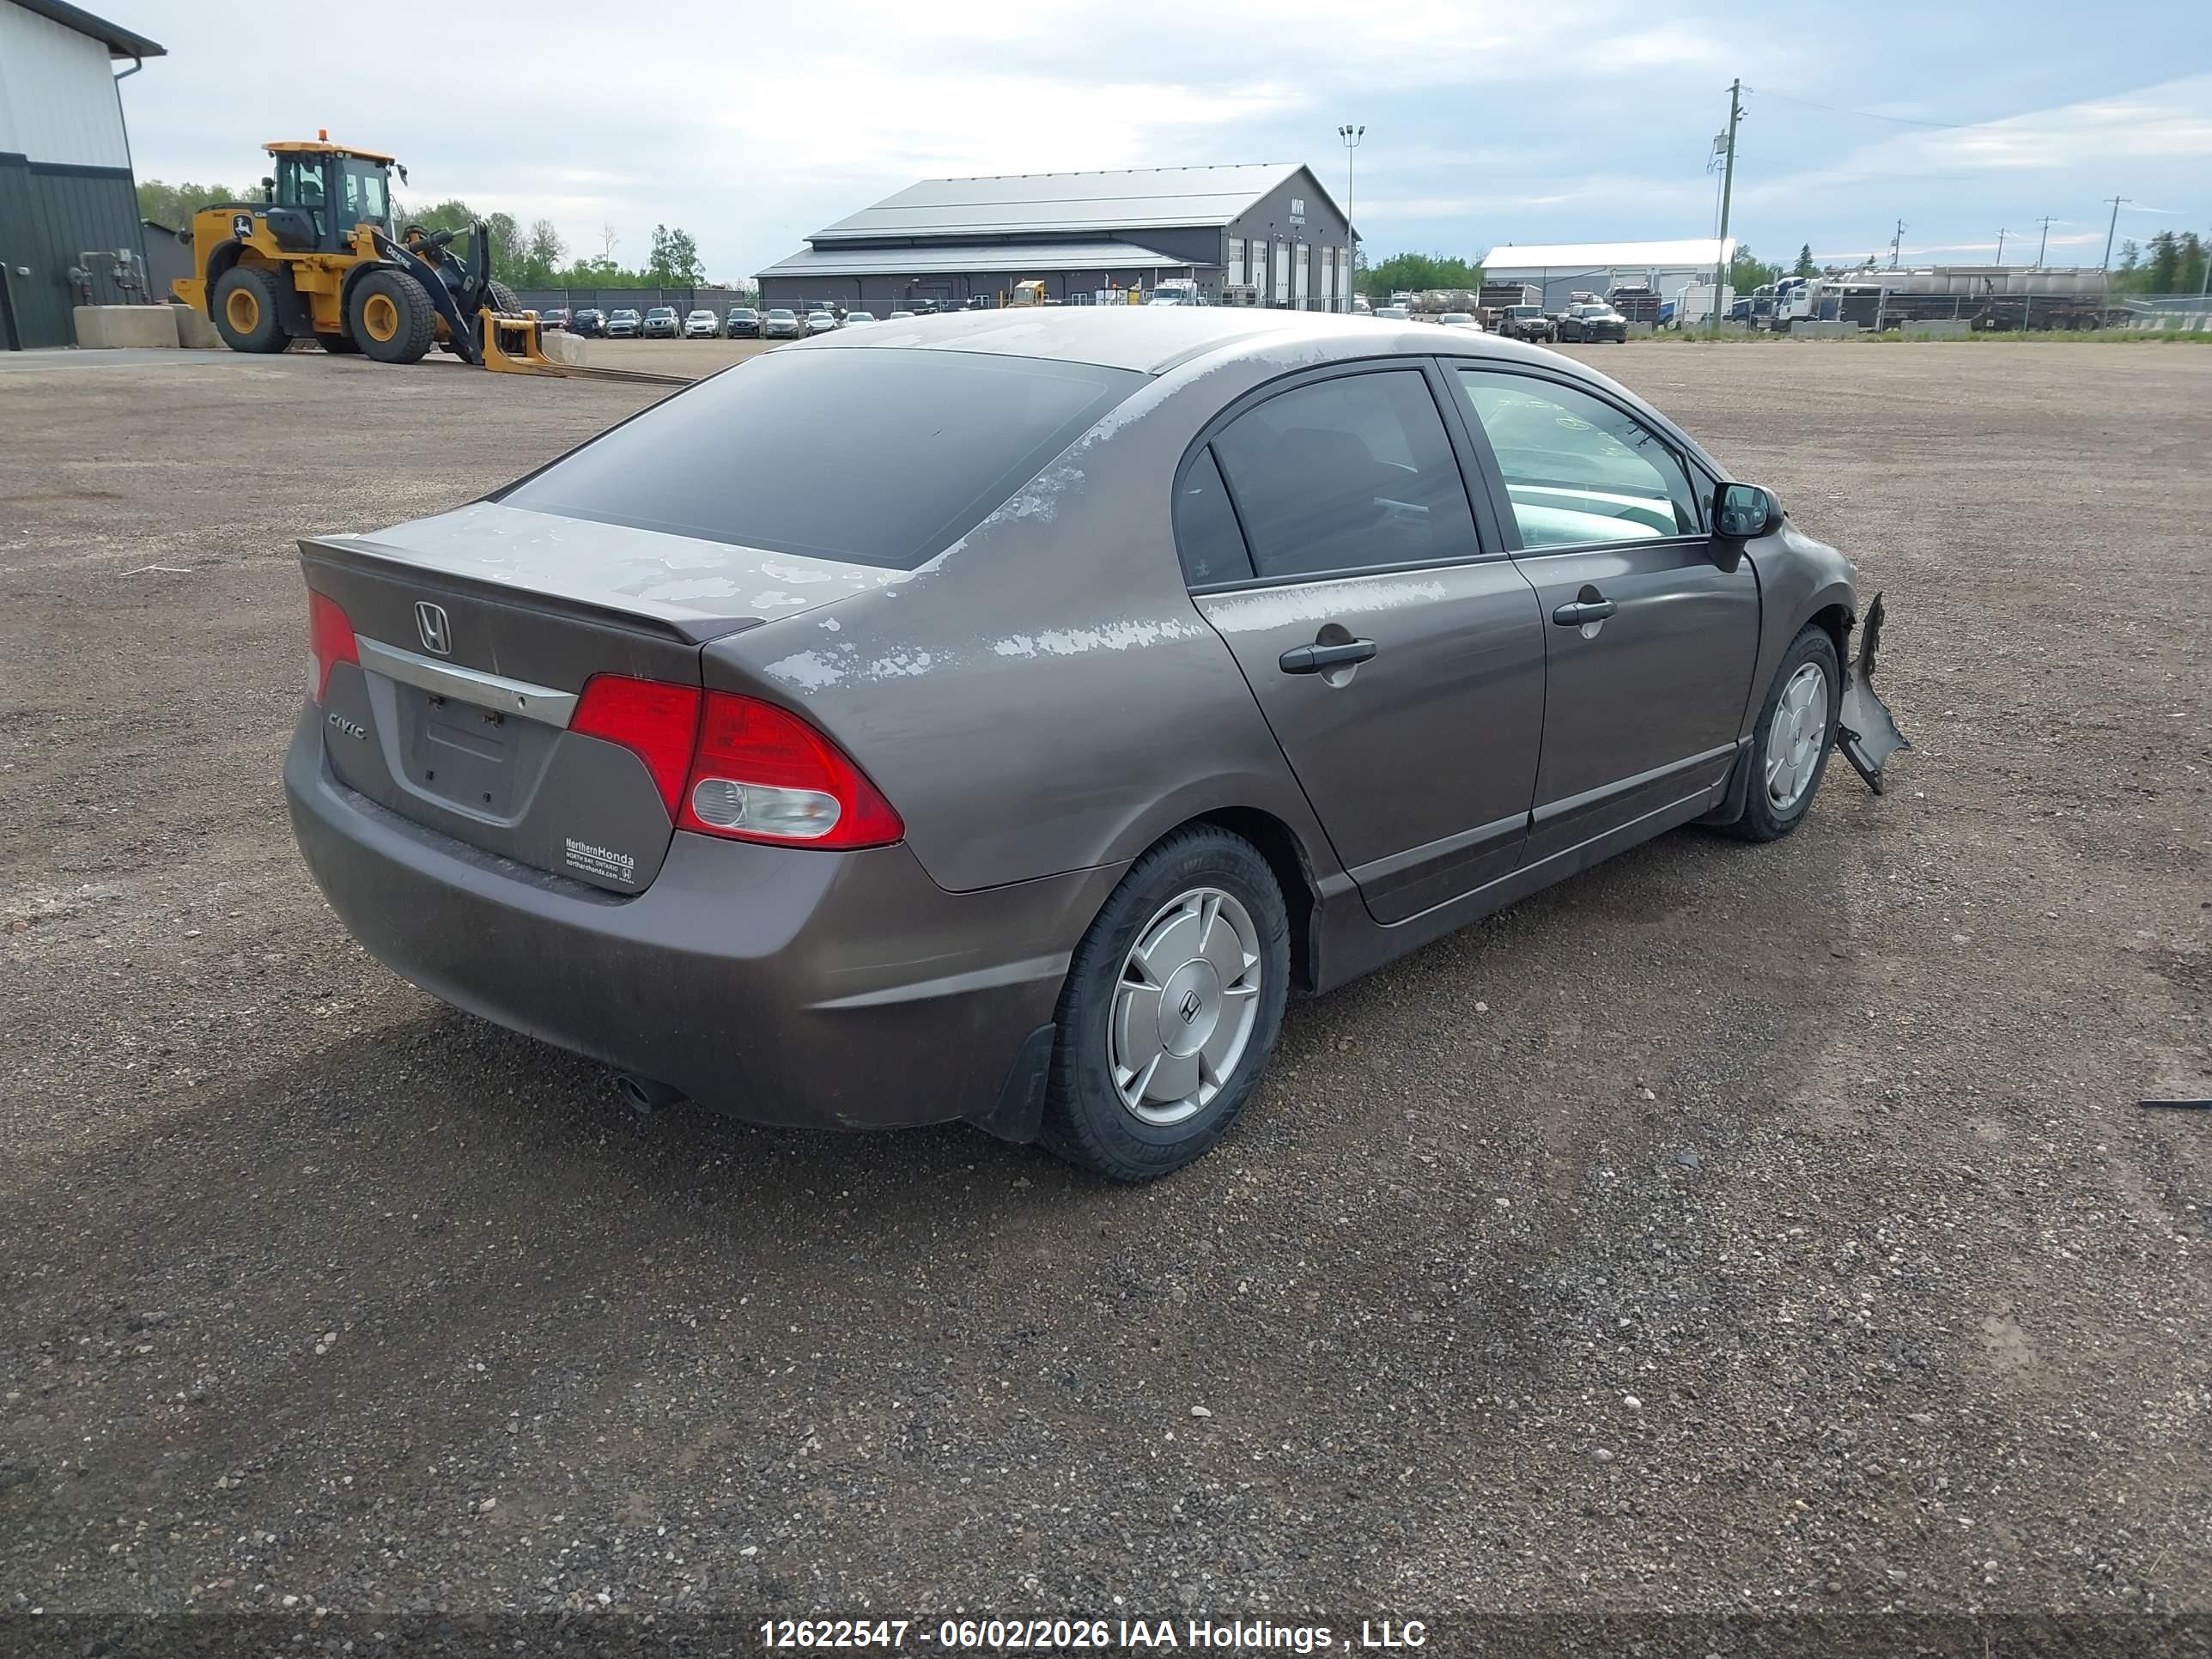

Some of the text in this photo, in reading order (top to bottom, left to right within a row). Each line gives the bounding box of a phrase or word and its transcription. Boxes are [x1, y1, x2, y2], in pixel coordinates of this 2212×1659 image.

[1291, 198, 1304, 216] MVR
[386, 244, 411, 270] DEERE
[566, 851, 583, 860] NORTH
[595, 860, 618, 872] ONTARIO
[566, 860, 618, 879] northernhonda.com
